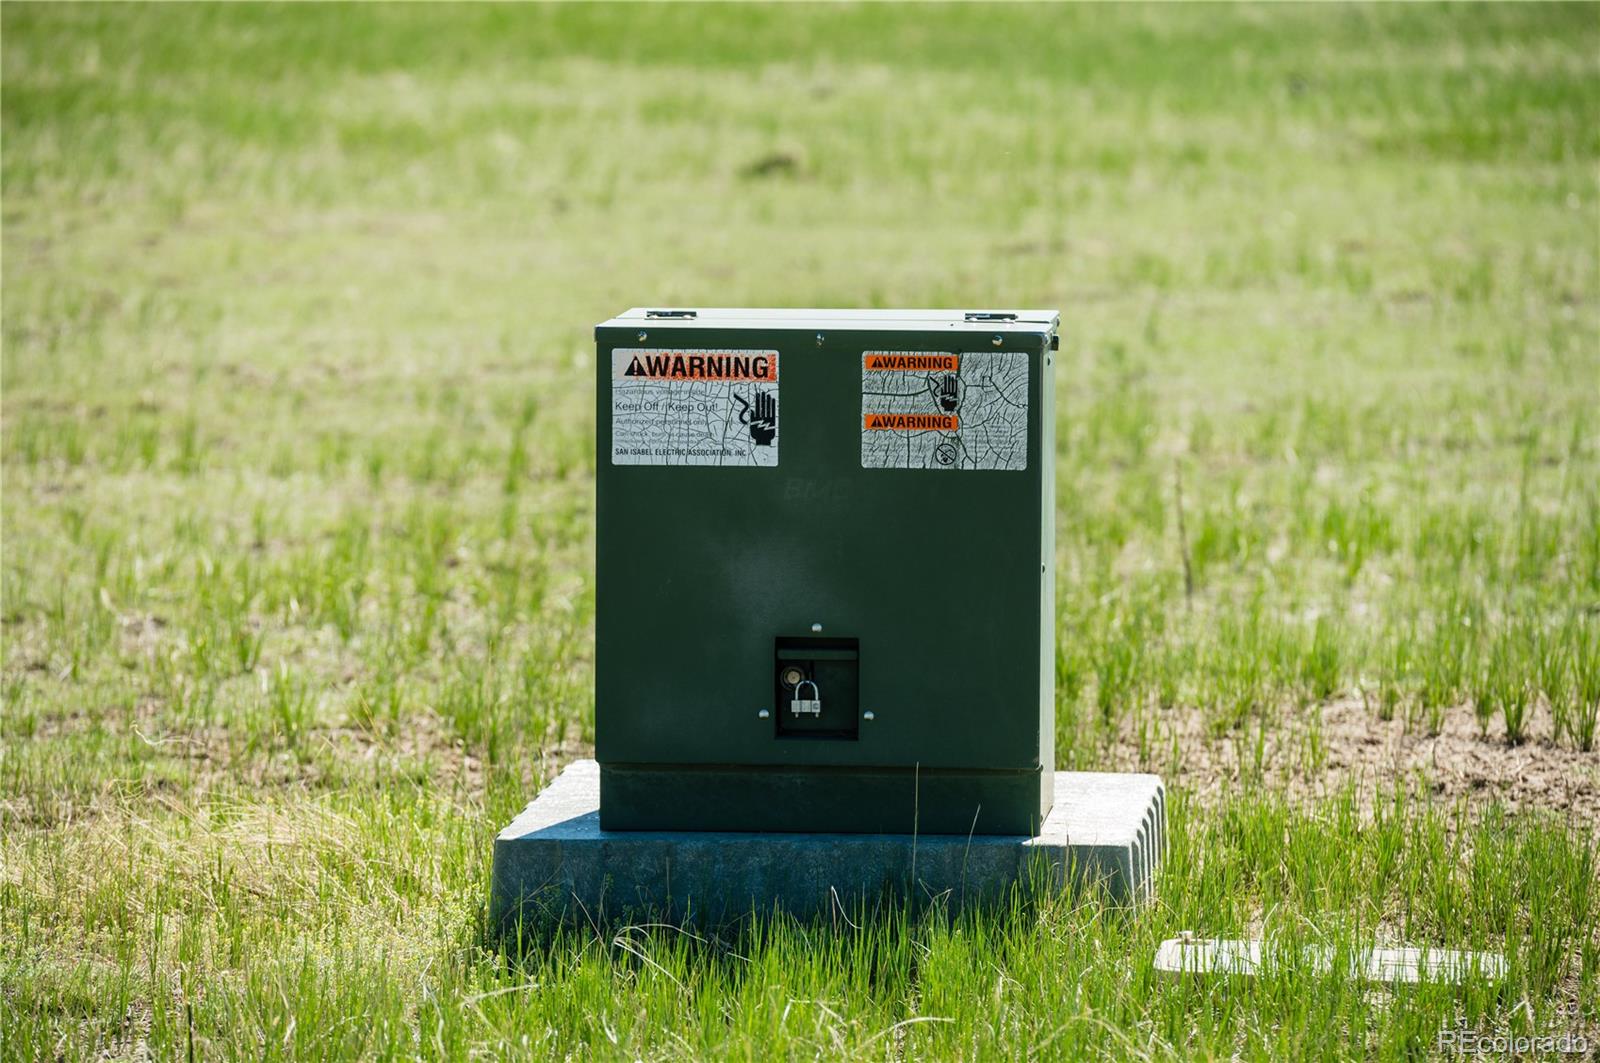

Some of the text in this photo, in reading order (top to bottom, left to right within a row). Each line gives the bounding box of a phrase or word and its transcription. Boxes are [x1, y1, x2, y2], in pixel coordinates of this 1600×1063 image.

[646, 355, 769, 378] WARNING
[883, 357, 953, 369] WARNING
[615, 402, 641, 414] Keep
[644, 402, 659, 411] Off
[668, 402, 694, 414] Keep
[883, 416, 952, 428] WARNING
[615, 448, 628, 456] SAN
[630, 448, 652, 456] ISABEL
[655, 448, 686, 456] ELECTRIC
